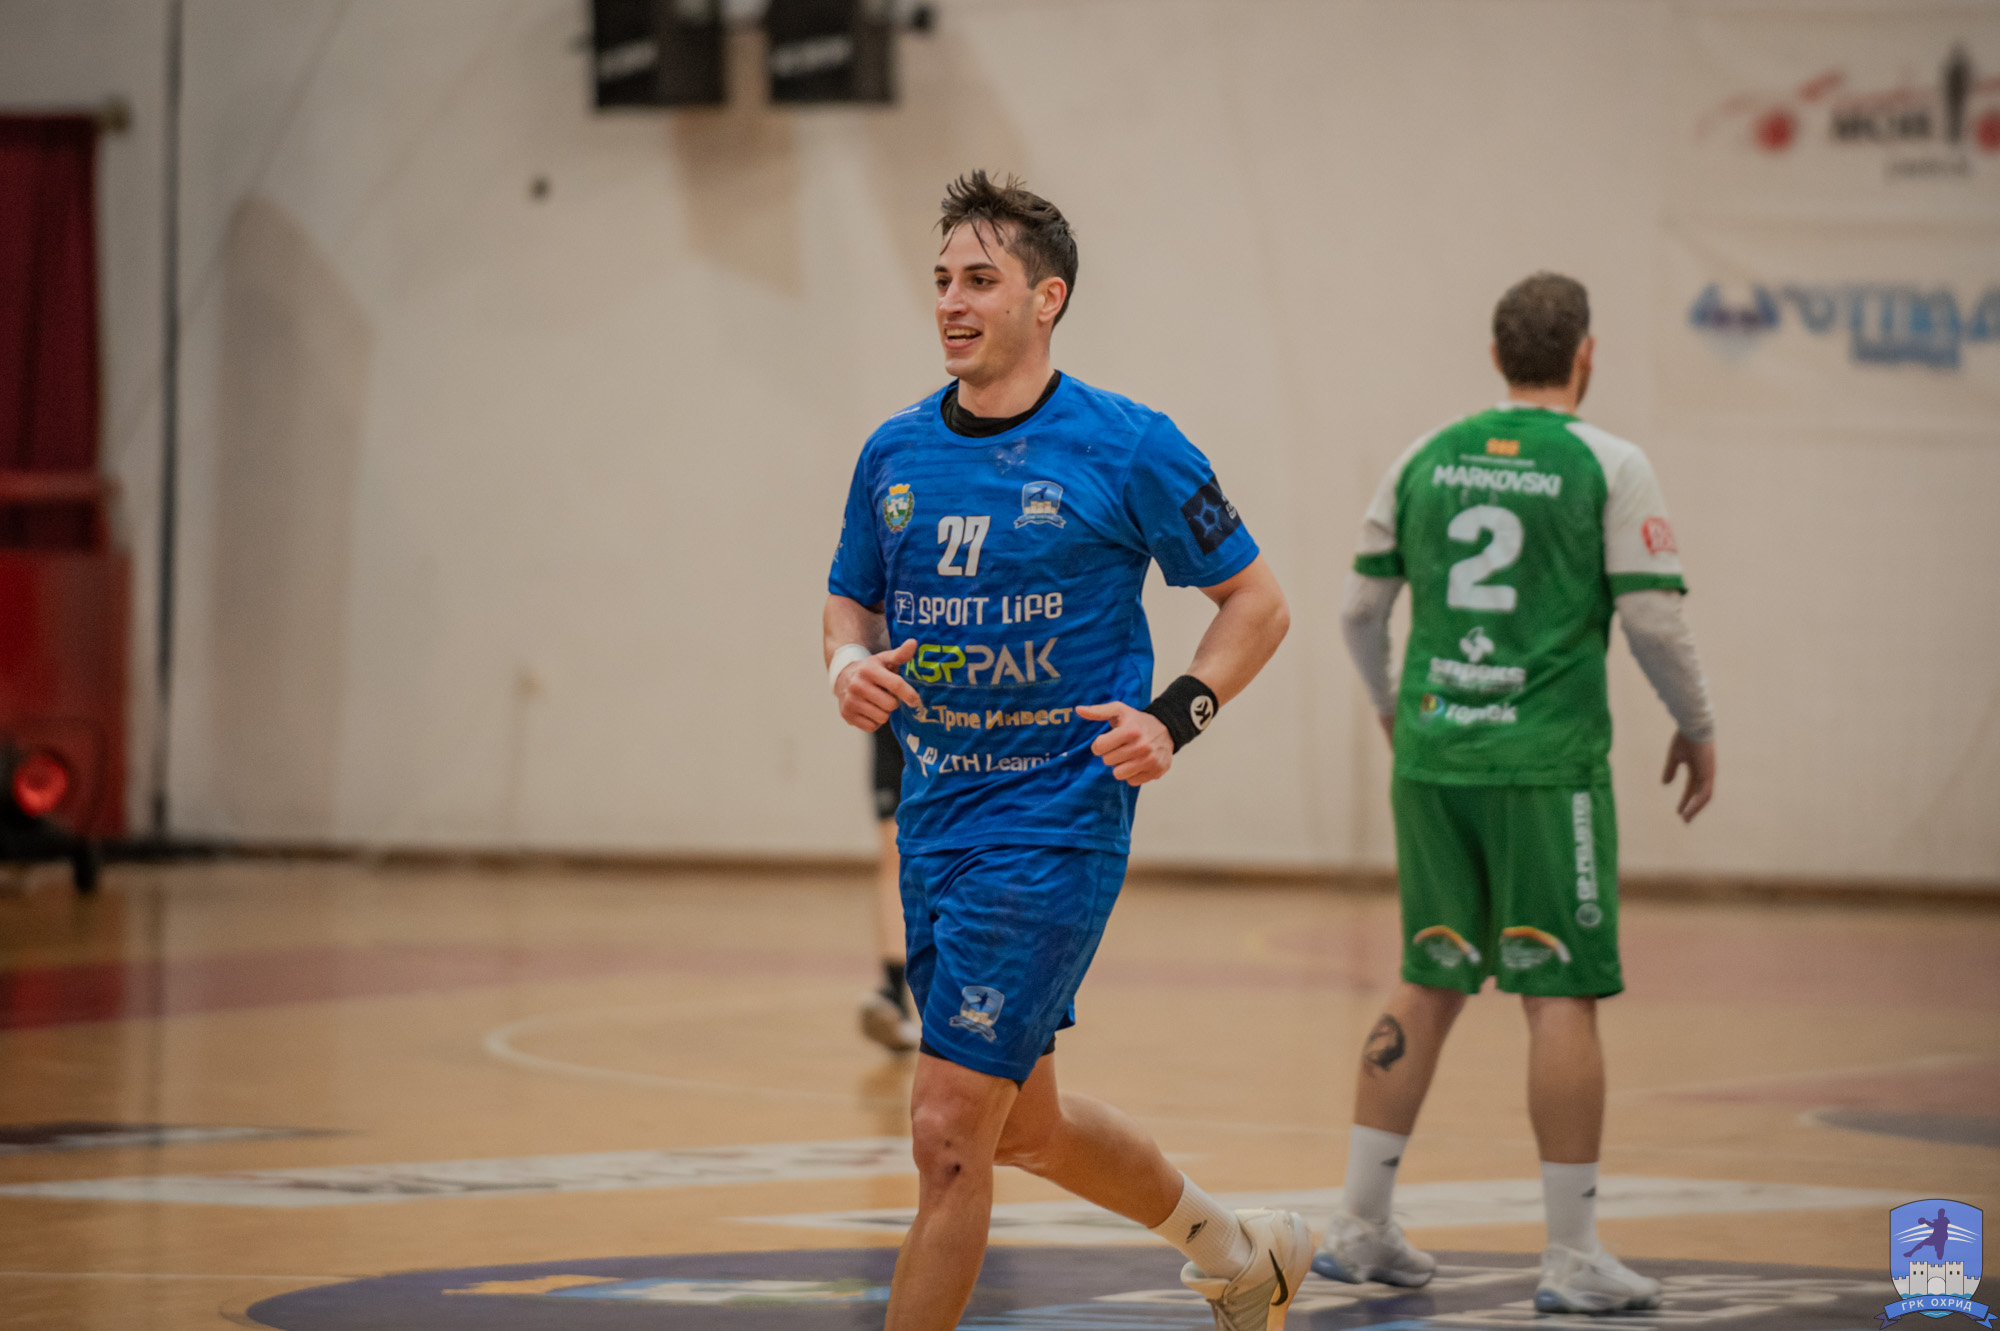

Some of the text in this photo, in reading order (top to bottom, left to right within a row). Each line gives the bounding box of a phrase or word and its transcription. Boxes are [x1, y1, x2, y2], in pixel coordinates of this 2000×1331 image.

[1432, 464, 1562, 497] MARKOVSKI
[936, 514, 991, 577] 27
[1447, 504, 1524, 613] 2
[917, 596, 990, 626] SPORT
[931, 704, 1074, 732] Трпе Инвест
